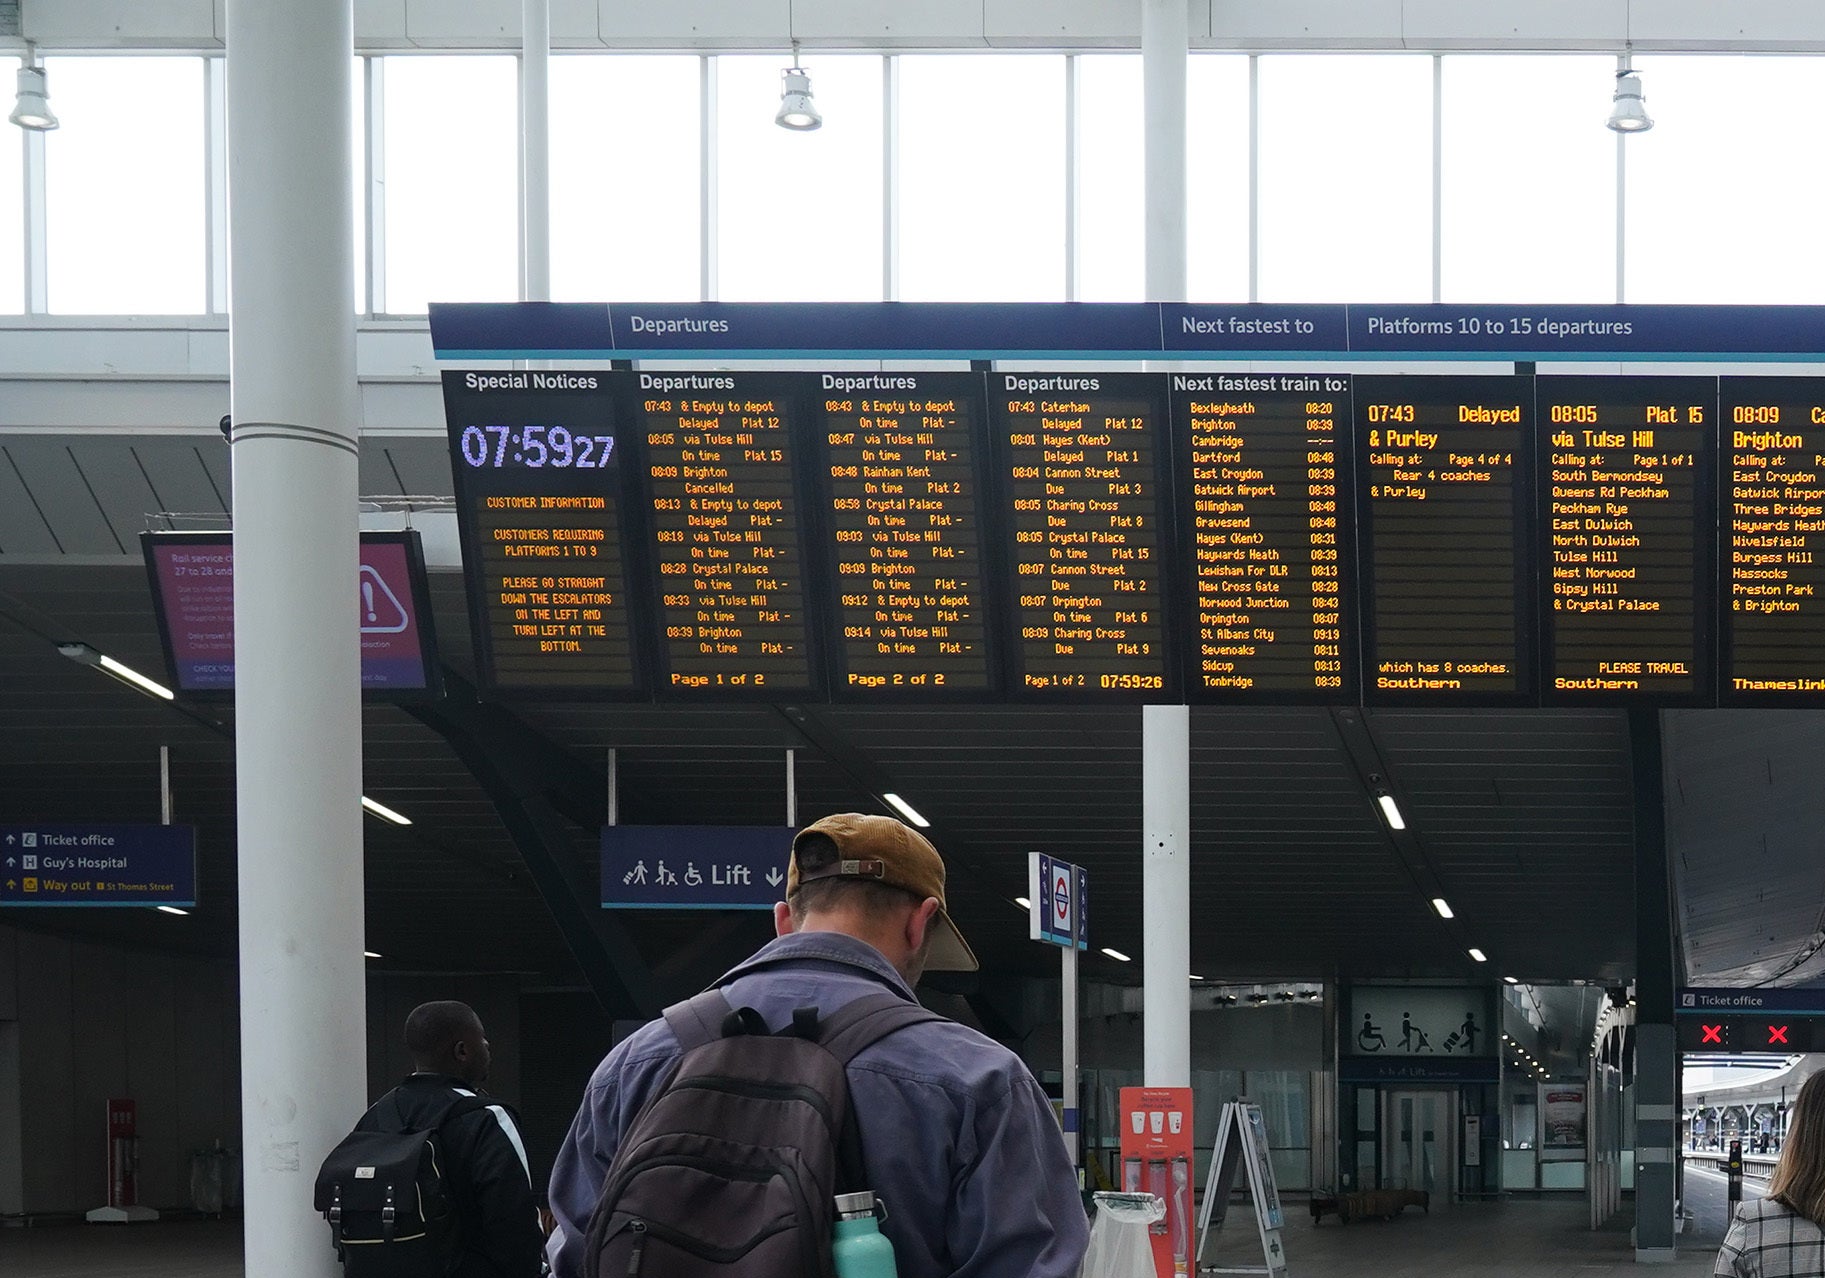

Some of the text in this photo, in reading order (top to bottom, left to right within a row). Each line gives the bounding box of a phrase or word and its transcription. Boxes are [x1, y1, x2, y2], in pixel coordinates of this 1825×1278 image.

[630, 315, 729, 336] Departures
[1182, 316, 1314, 334] Next fastest to
[1368, 316, 1633, 338] Platforms 10 to 15 departures
[465, 372, 598, 392] Special Notices
[639, 374, 735, 393] Departures
[821, 374, 917, 393] Departures
[1004, 375, 1100, 394] Departures
[1173, 375, 1348, 392] Next fastest train to:
[1190, 402, 1333, 417] Bexleyheath 08:20
[1368, 405, 1521, 425] 07:43 Delayed
[1551, 405, 1703, 424] 08:05 Plat 15
[1733, 406, 1780, 424] 08:09
[1369, 429, 1438, 450] & Purley
[1551, 430, 1654, 448] via Tulse Hill
[1733, 430, 1803, 452] Brighton
[1193, 467, 1335, 482] East Croydon 08:39
[1194, 483, 1336, 498] Gatwick Airport 08:39
[486, 496, 605, 509] CUSTOMER INFORMATION
[493, 529, 605, 541] CUSTOMERS REQUIRING
[504, 545, 598, 557] PLATFORMS 1 TO 9
[502, 577, 606, 589] PLEASE GO STRAIGHT
[500, 592, 612, 605] DOWN THE ESCALATORS
[515, 608, 602, 621] ON THE LEFT AND
[512, 624, 607, 637] TURN LEFT AT THE
[540, 640, 582, 652] BOTTOM.
[1377, 677, 1461, 689] Southern
[1554, 677, 1639, 690] Southern
[41, 834, 115, 846] Ticket office
[42, 856, 128, 871] Guy's Hospital
[711, 864, 752, 886] Lift
[43, 880, 91, 892] Way out
[105, 882, 174, 892] St Thomas Street
[1700, 995, 1763, 1006] Ticket office
